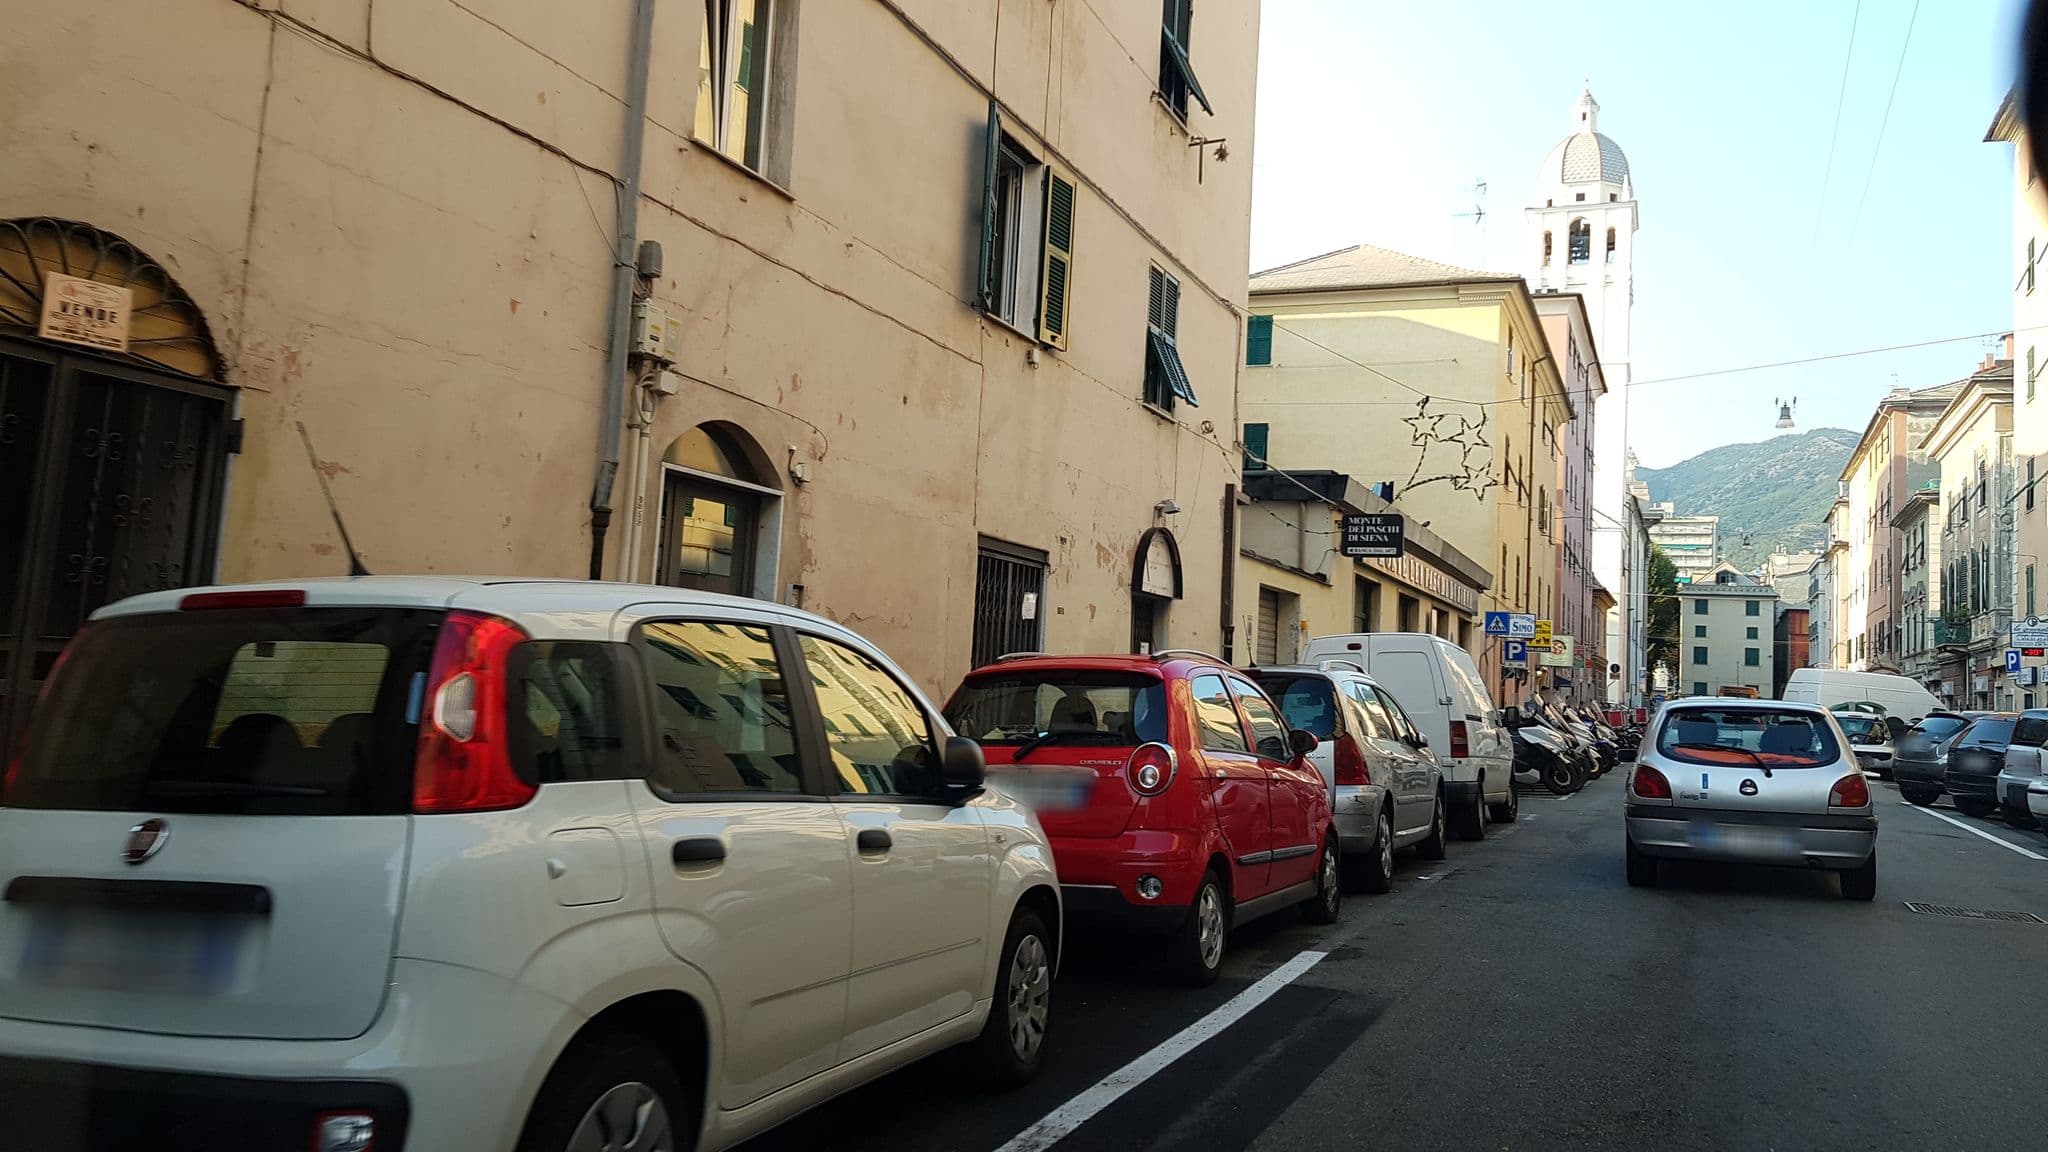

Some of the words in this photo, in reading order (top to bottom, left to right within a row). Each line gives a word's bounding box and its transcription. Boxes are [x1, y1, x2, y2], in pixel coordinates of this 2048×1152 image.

[1348, 517, 1384, 525] MONTE
[1348, 525, 1365, 533] DEI
[1366, 525, 1400, 533] PASCHI
[1348, 534, 1358, 542] DI
[1359, 534, 1389, 542] SIENA
[1508, 643, 1522, 659] P
[2007, 652, 2017, 669] P
